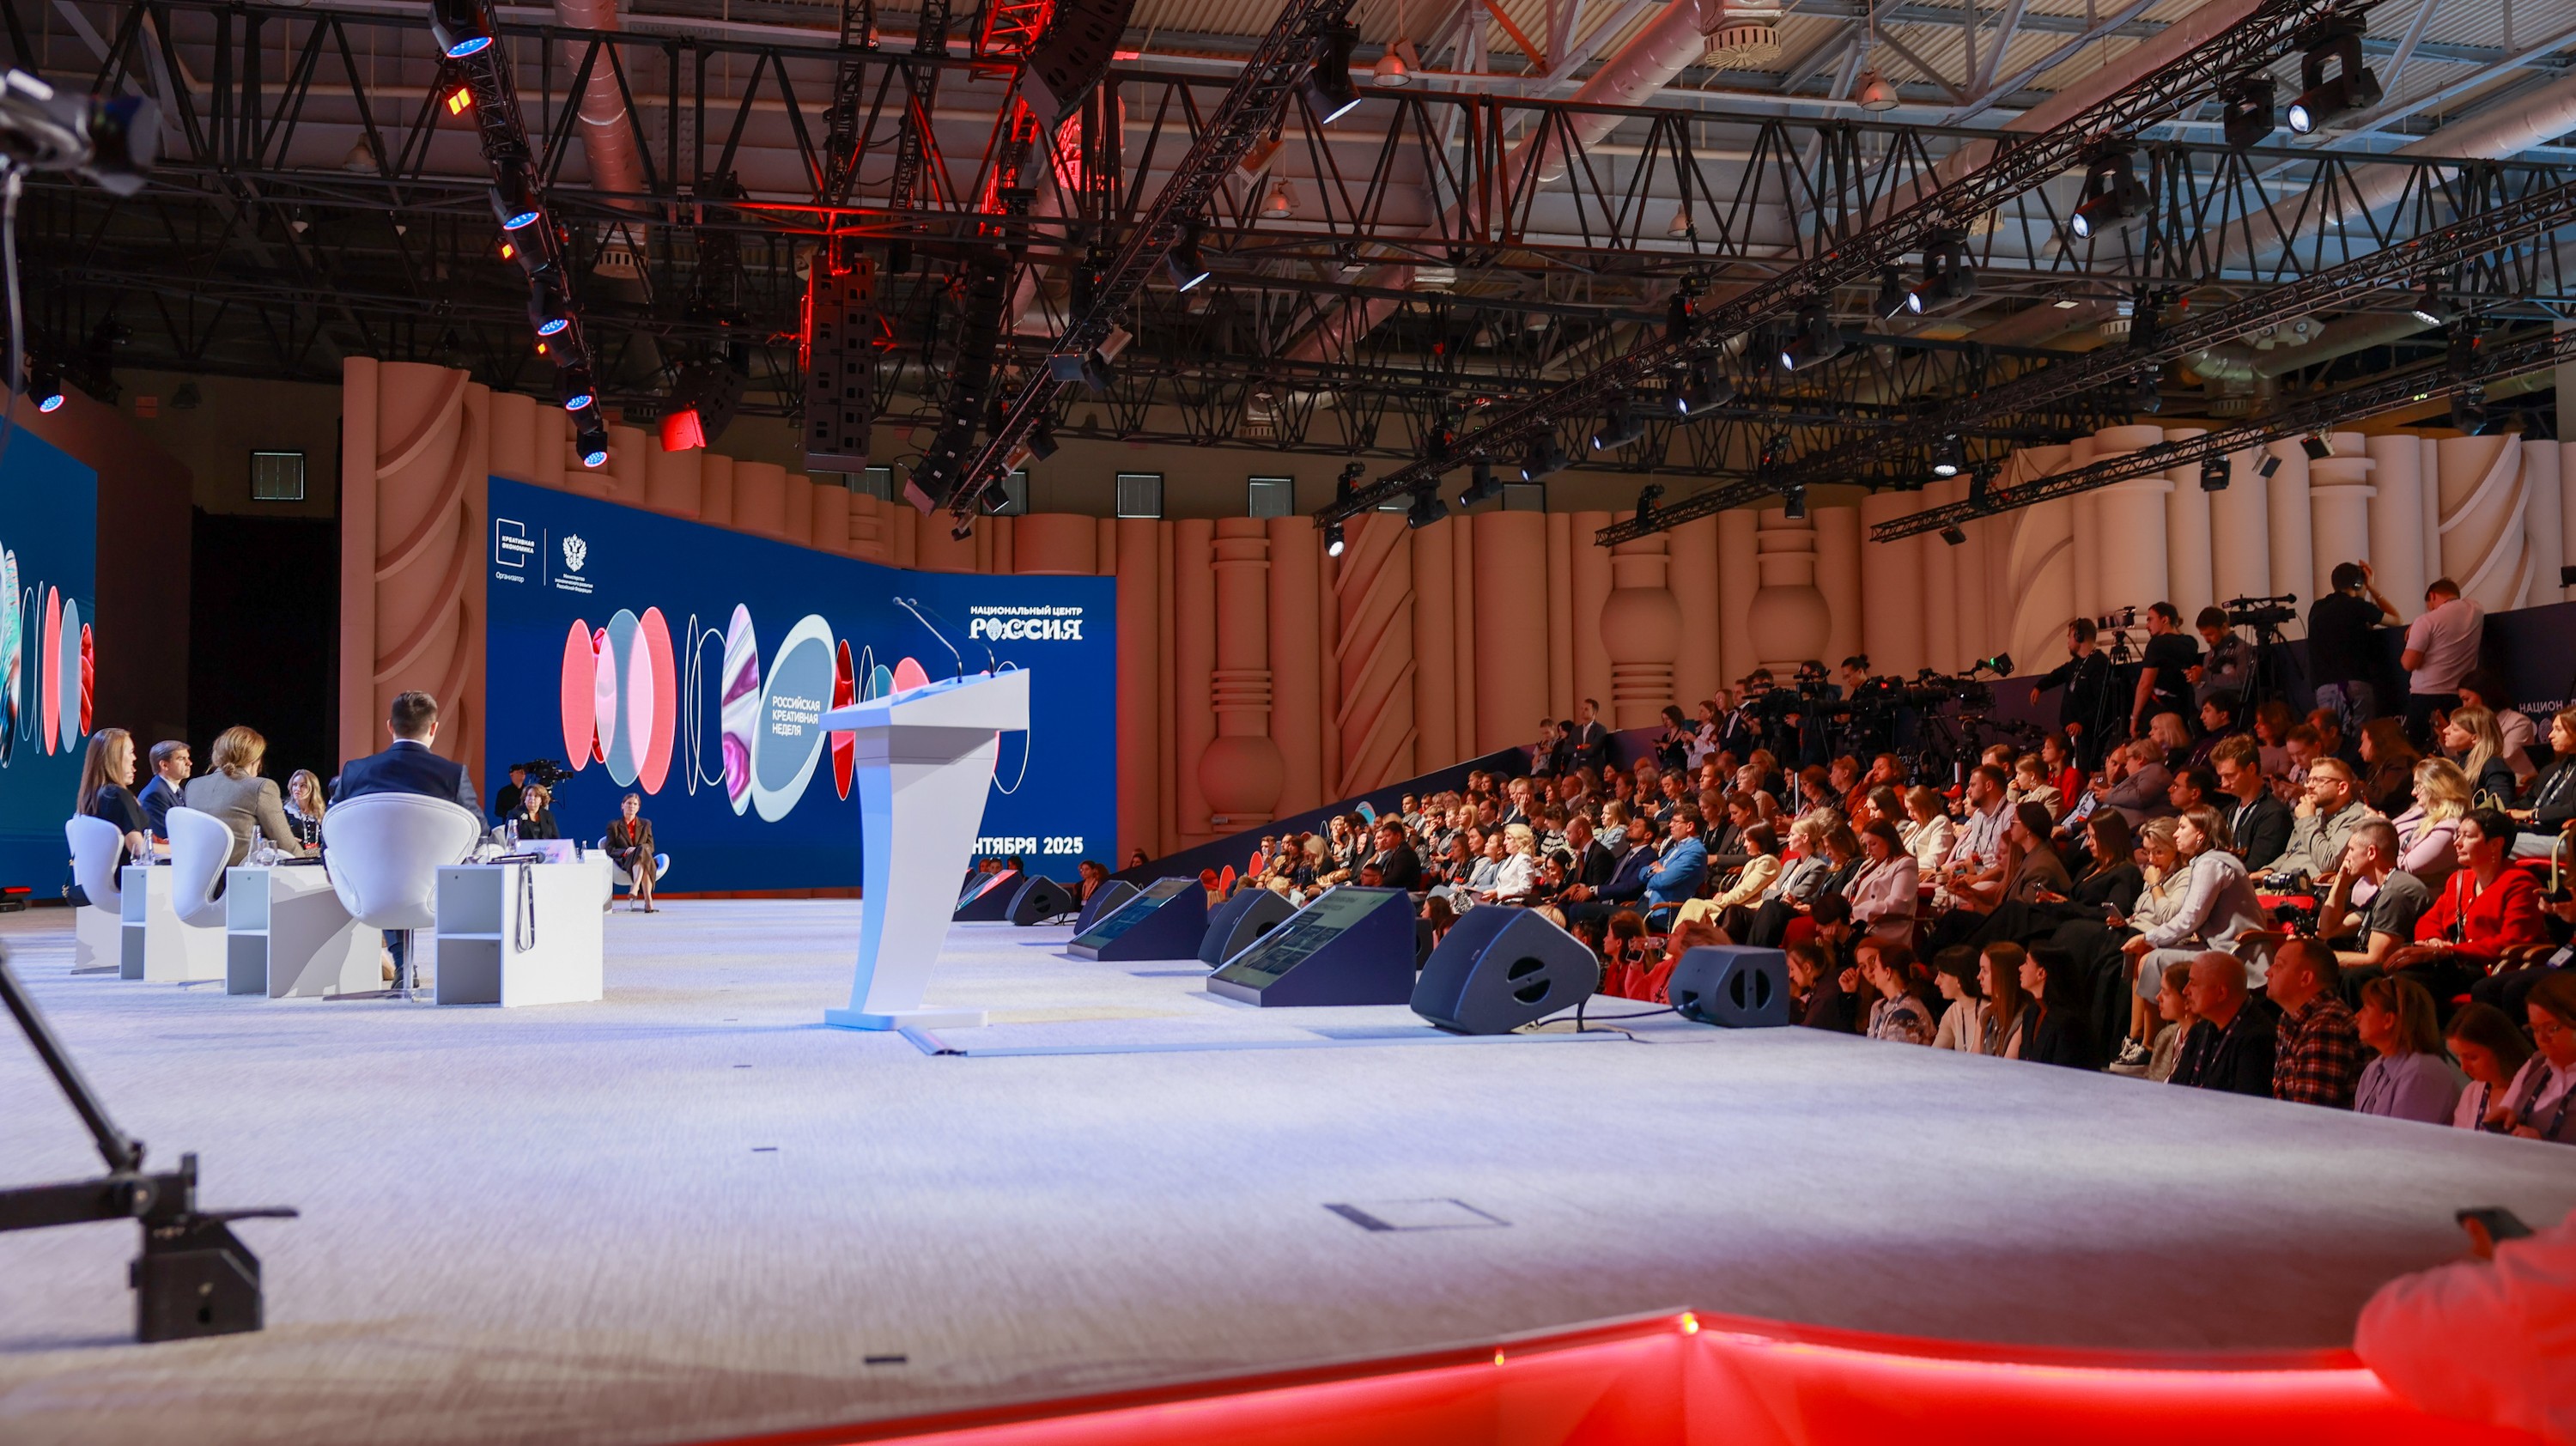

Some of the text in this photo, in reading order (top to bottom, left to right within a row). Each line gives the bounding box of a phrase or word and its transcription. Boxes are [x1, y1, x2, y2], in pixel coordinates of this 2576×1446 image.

[501, 536, 534, 547] КРЕАТИВНАЯ
[501, 543, 534, 554] ЭКОНОМИКА
[495, 571, 525, 584] Организатор
[970, 605, 1084, 617] НАЦИОНАЛЬНЫЙ ЦЕНТР
[969, 617, 1084, 642] РОССИЯ
[772, 696, 821, 712] РОССИЙСКАЯ
[2518, 698, 2576, 714] НАЦИОН
[772, 709, 819, 725] КРЕАТИВНАЯ
[772, 723, 802, 737] НЕДЕЛЯ
[971, 836, 1084, 855] НТЯБРЯ 2025
